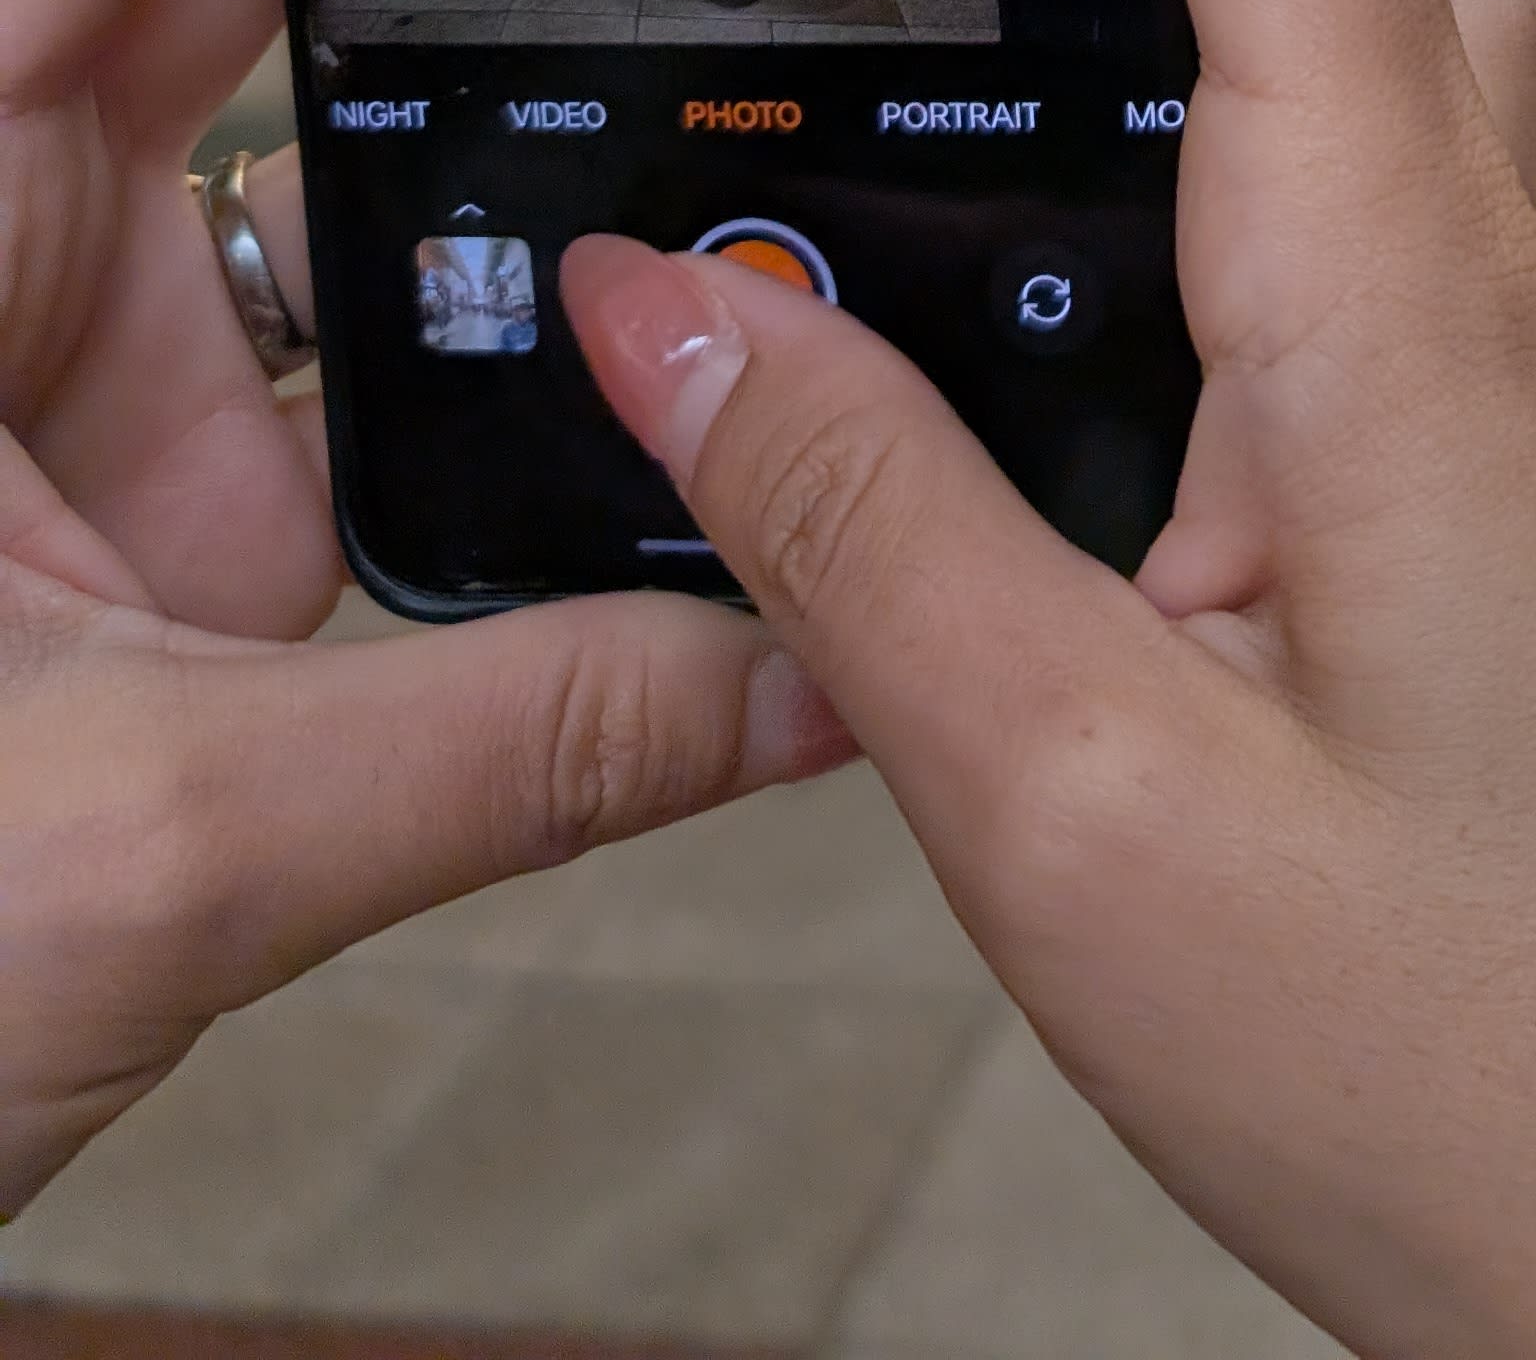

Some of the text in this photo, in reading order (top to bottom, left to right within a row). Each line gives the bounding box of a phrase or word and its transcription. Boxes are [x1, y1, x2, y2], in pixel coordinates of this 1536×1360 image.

[333, 99, 1186, 130] NIGHT VIDEO PHOTO PORTRAIT MO
